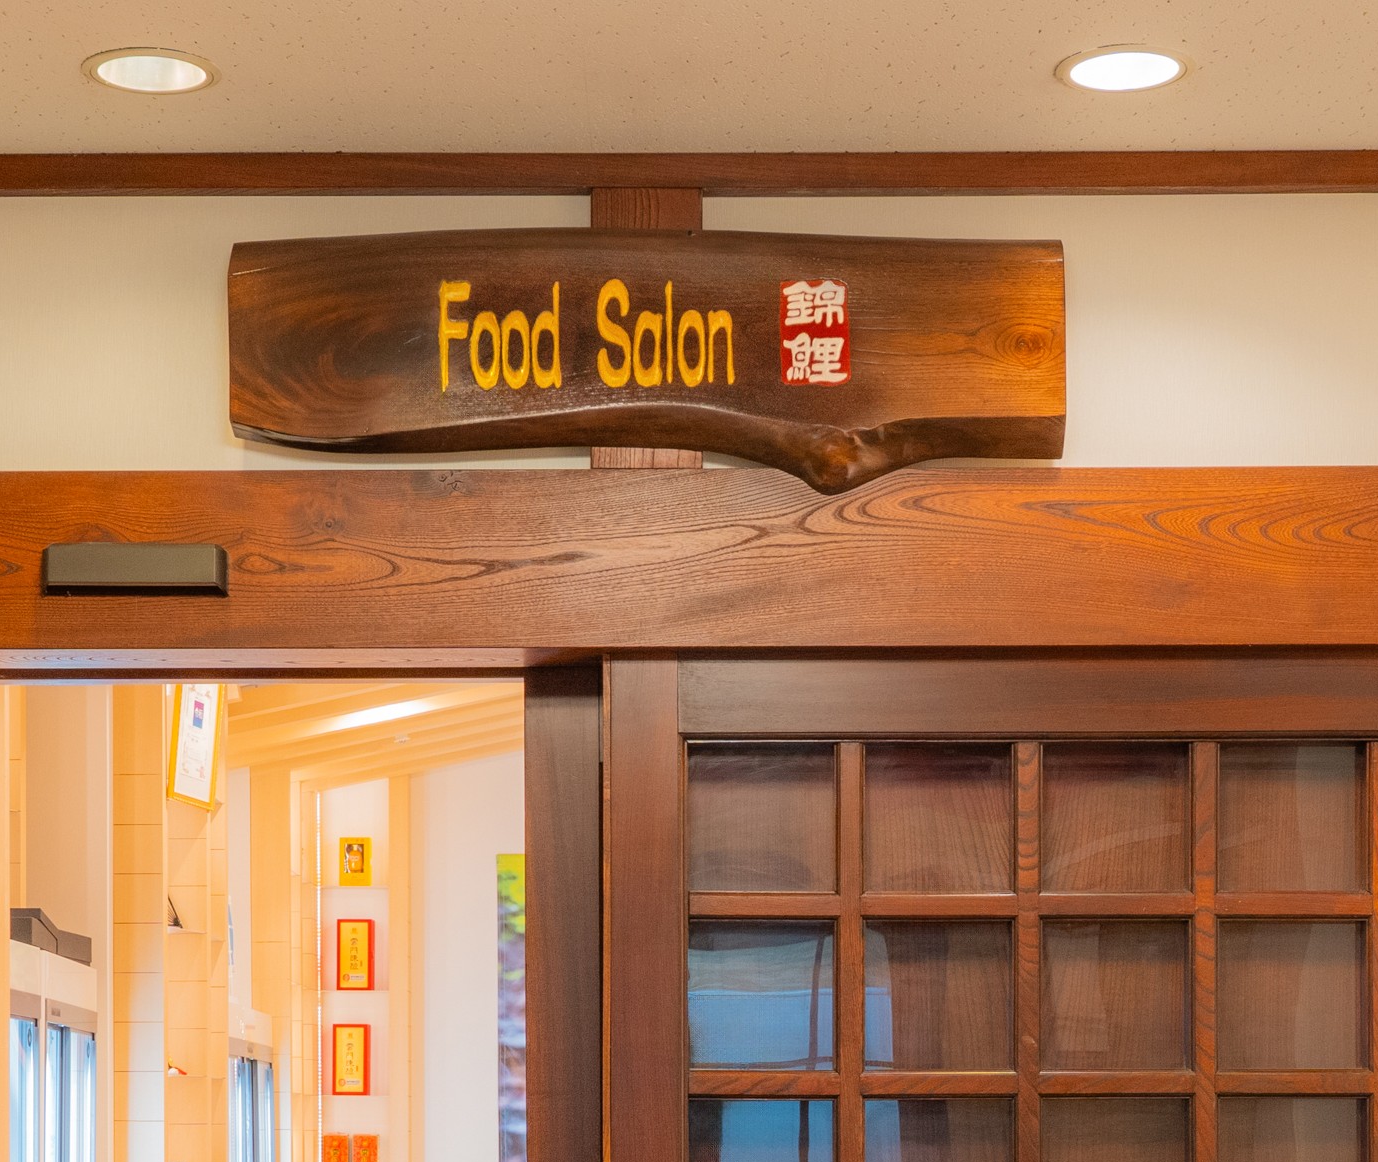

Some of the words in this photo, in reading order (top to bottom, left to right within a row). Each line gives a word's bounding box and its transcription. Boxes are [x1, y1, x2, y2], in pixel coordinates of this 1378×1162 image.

[438, 280, 562, 392] Food
[595, 278, 736, 388] Salon
[783, 280, 850, 385] 錦鯉
